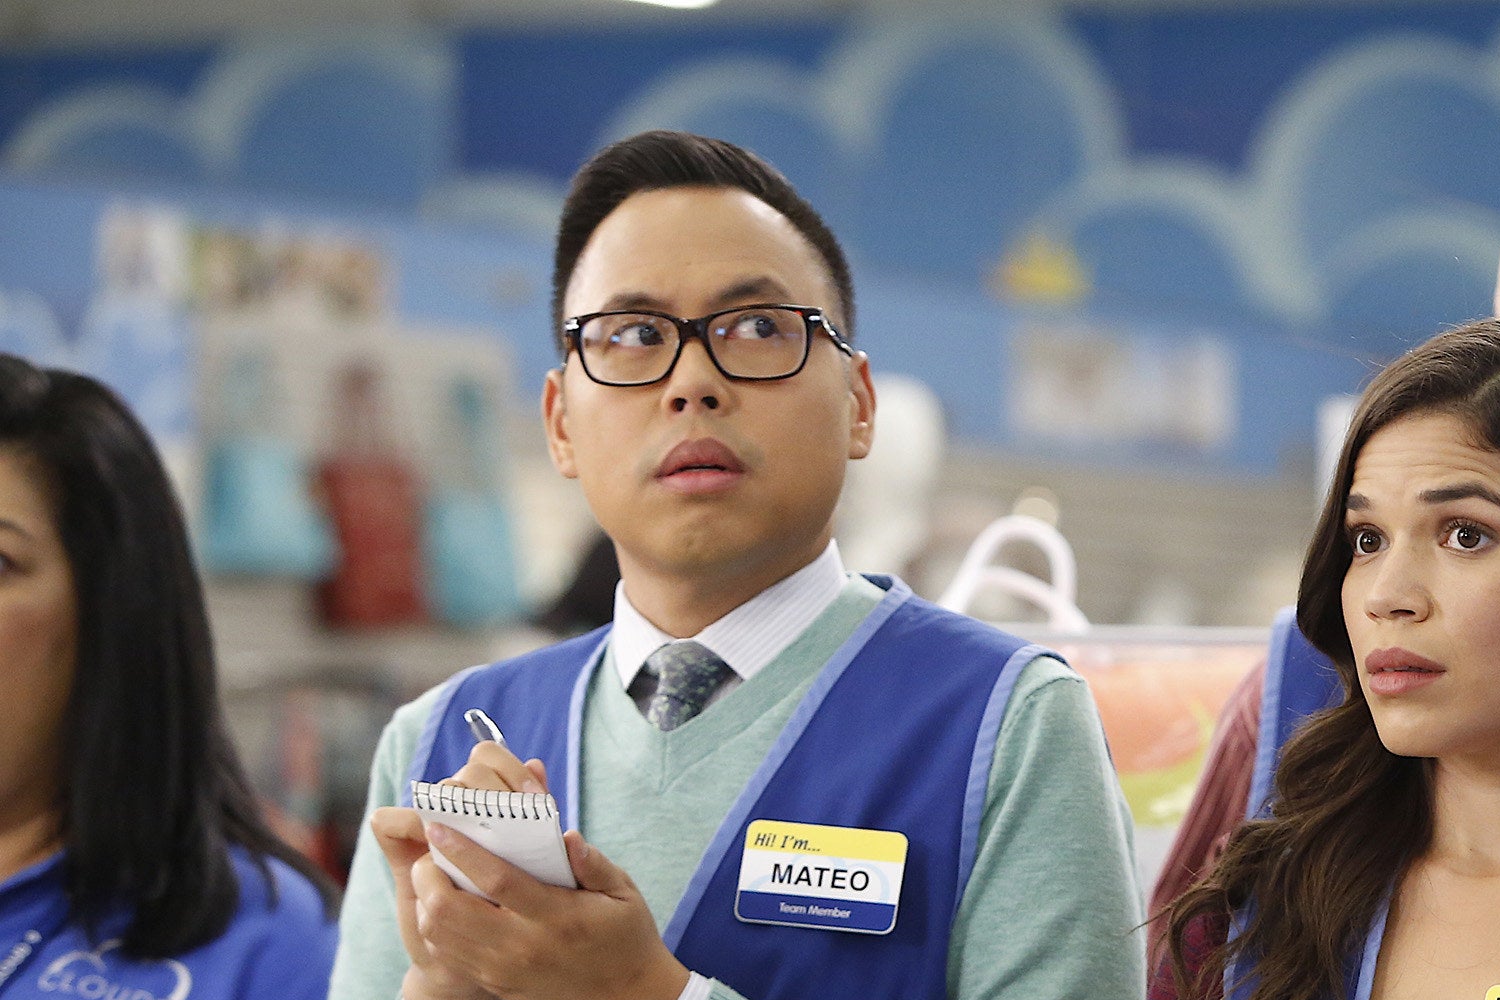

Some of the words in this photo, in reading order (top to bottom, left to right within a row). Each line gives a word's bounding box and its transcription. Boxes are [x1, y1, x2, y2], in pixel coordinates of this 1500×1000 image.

[754, 833, 777, 847] Hi!
[771, 863, 870, 891] MATEO
[779, 902, 806, 915] Team
[808, 903, 851, 918] Member
